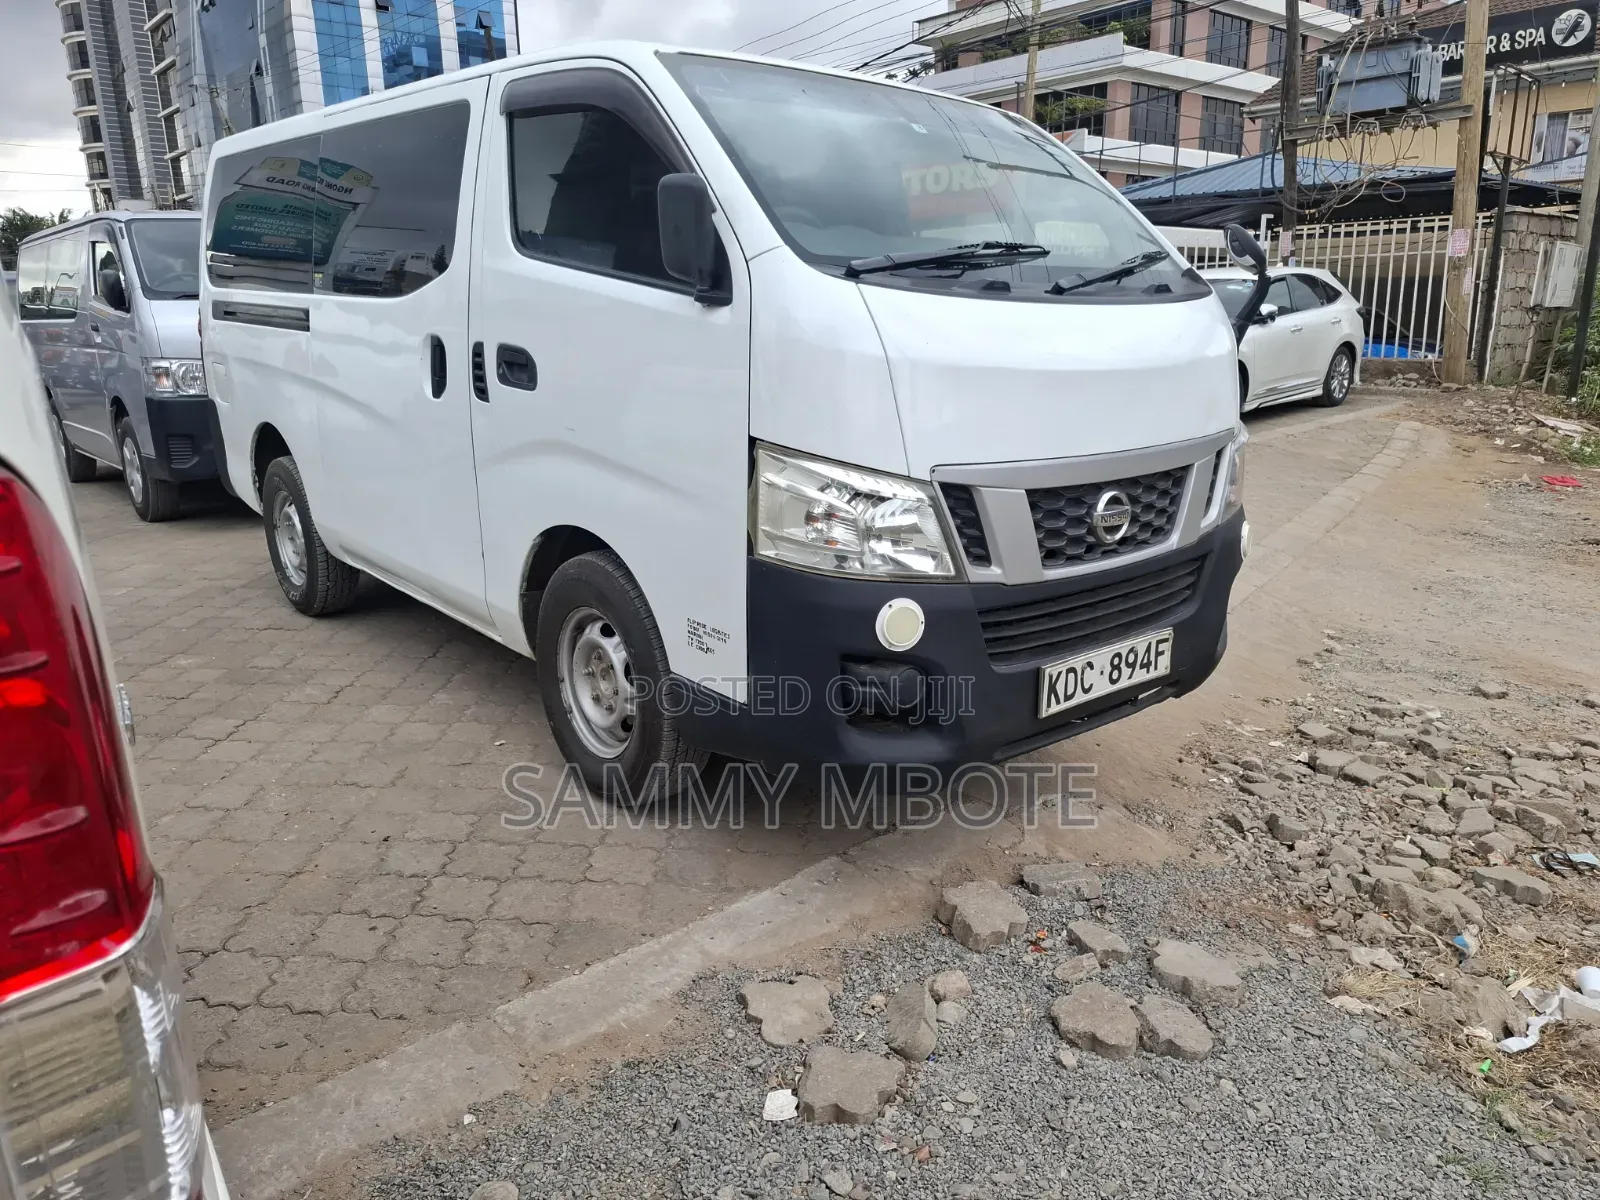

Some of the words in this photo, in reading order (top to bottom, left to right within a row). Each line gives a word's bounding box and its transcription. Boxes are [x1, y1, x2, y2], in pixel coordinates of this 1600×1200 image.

[1438, 35, 1497, 62] BARR
[1499, 32, 1512, 53] &
[1514, 26, 1547, 51] SPA
[1046, 660, 1095, 709] KDC
[1108, 637, 1170, 686] 894F
